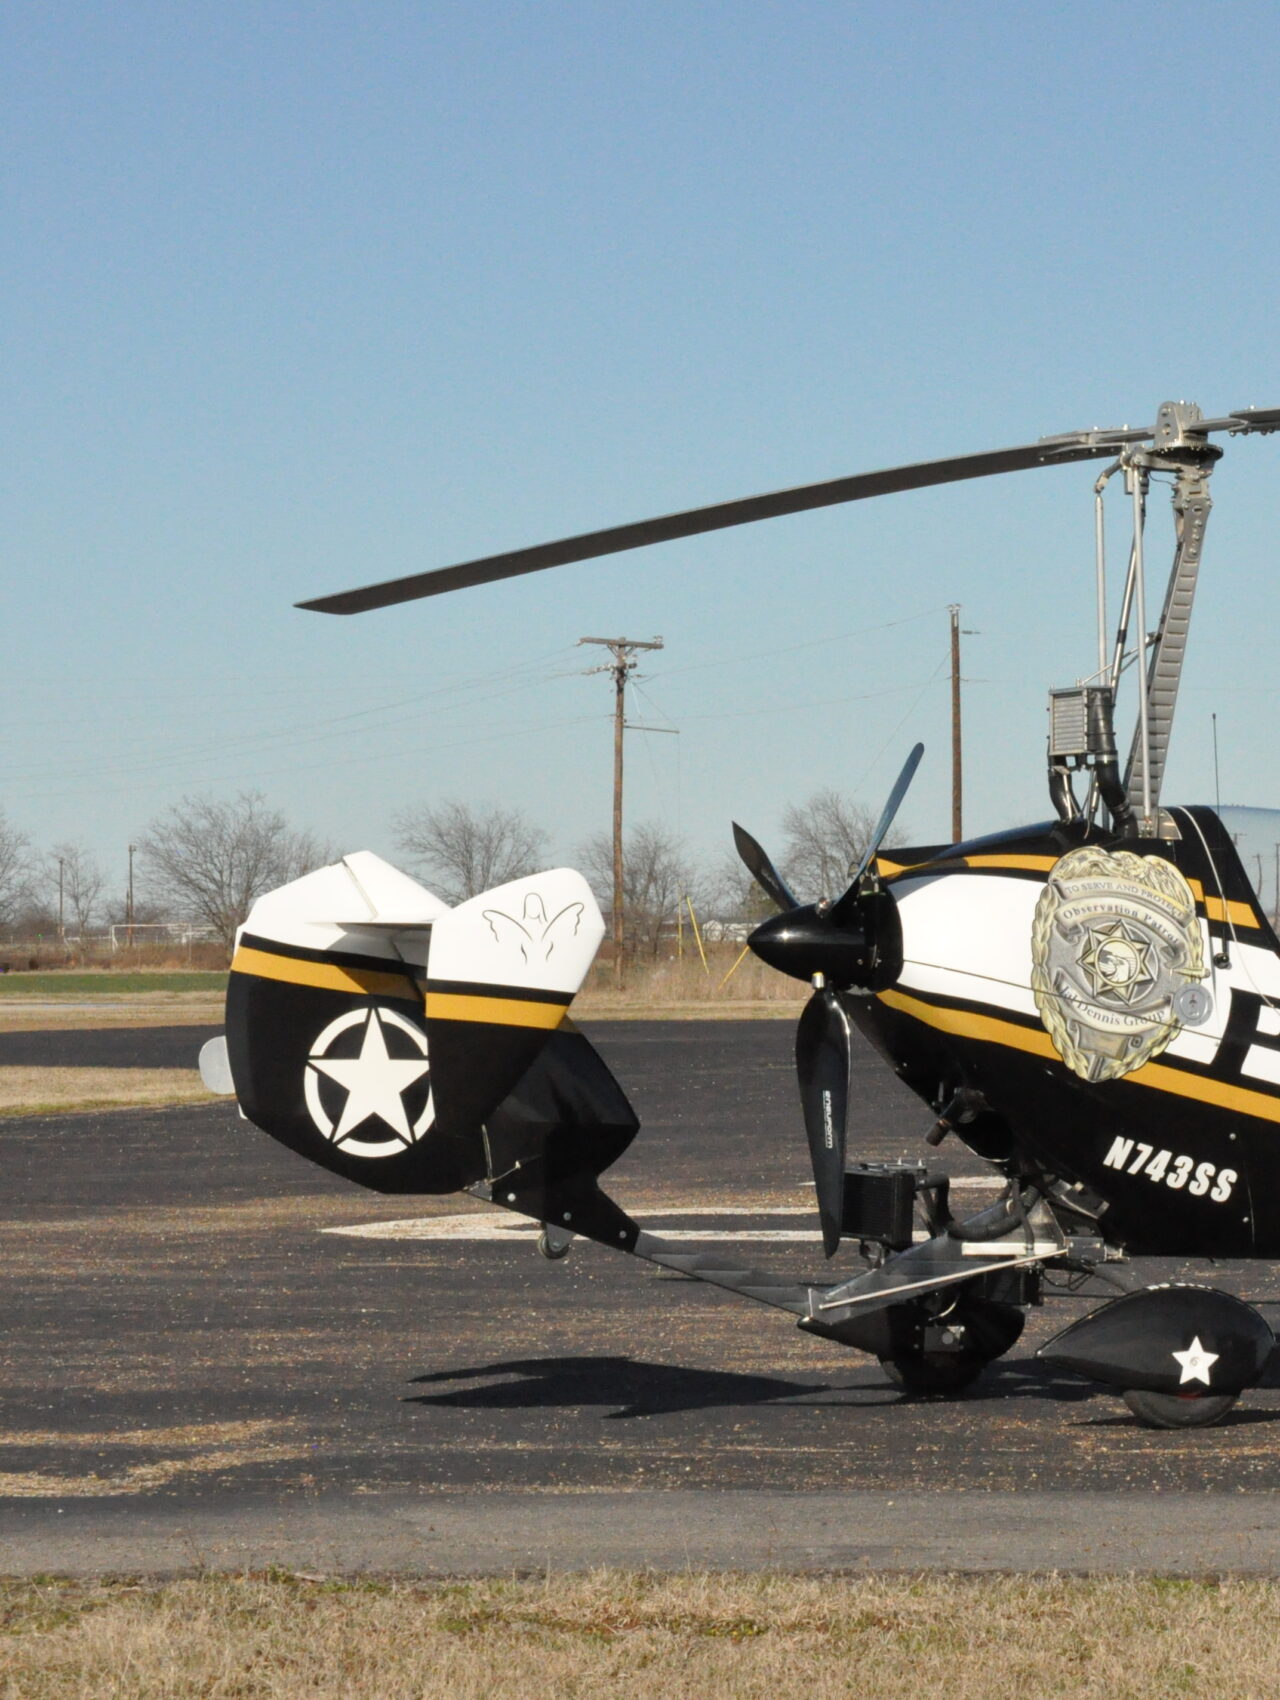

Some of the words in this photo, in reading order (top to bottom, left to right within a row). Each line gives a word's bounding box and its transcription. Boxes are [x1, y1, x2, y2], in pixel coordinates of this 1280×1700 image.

[1065, 886, 1080, 895] TO
[1082, 881, 1113, 891] SERVE
[1116, 883, 1139, 893] AND
[1141, 889, 1185, 918] PROTECT
[1063, 903, 1139, 920] Observation
[1144, 913, 1180, 945] Patrol
[1077, 1001, 1121, 1026] Dennis
[1123, 1009, 1165, 1027] Group
[1102, 1135, 1238, 1203] N743SS
